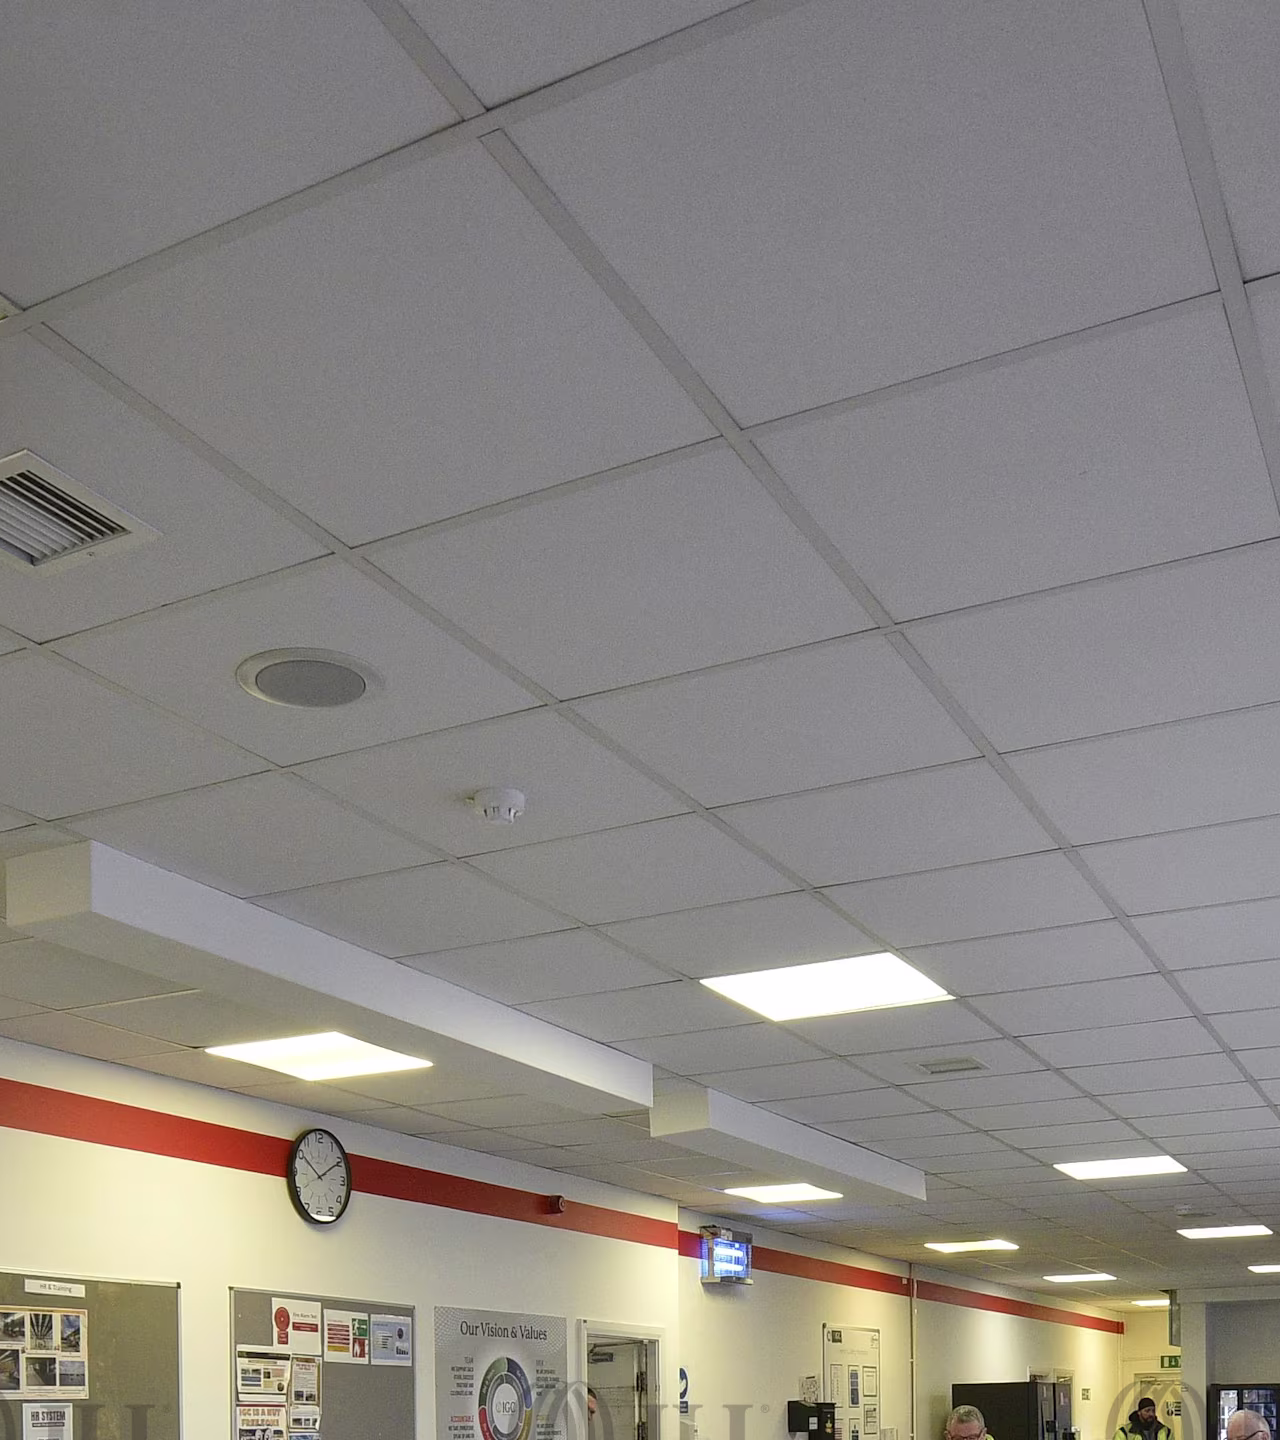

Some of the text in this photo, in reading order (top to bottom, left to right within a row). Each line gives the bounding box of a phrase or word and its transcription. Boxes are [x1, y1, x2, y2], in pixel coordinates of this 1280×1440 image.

[304, 1137, 310, 1148] 11
[314, 1132, 324, 1144] 12
[330, 1142, 334, 1152] 1
[339, 1176, 345, 1187] 3
[336, 1195, 342, 1205] 4
[328, 1206, 334, 1217] 5
[460, 1320, 548, 1341] Our Vision & Values
[30, 1411, 66, 1422] HR SYSTEM
